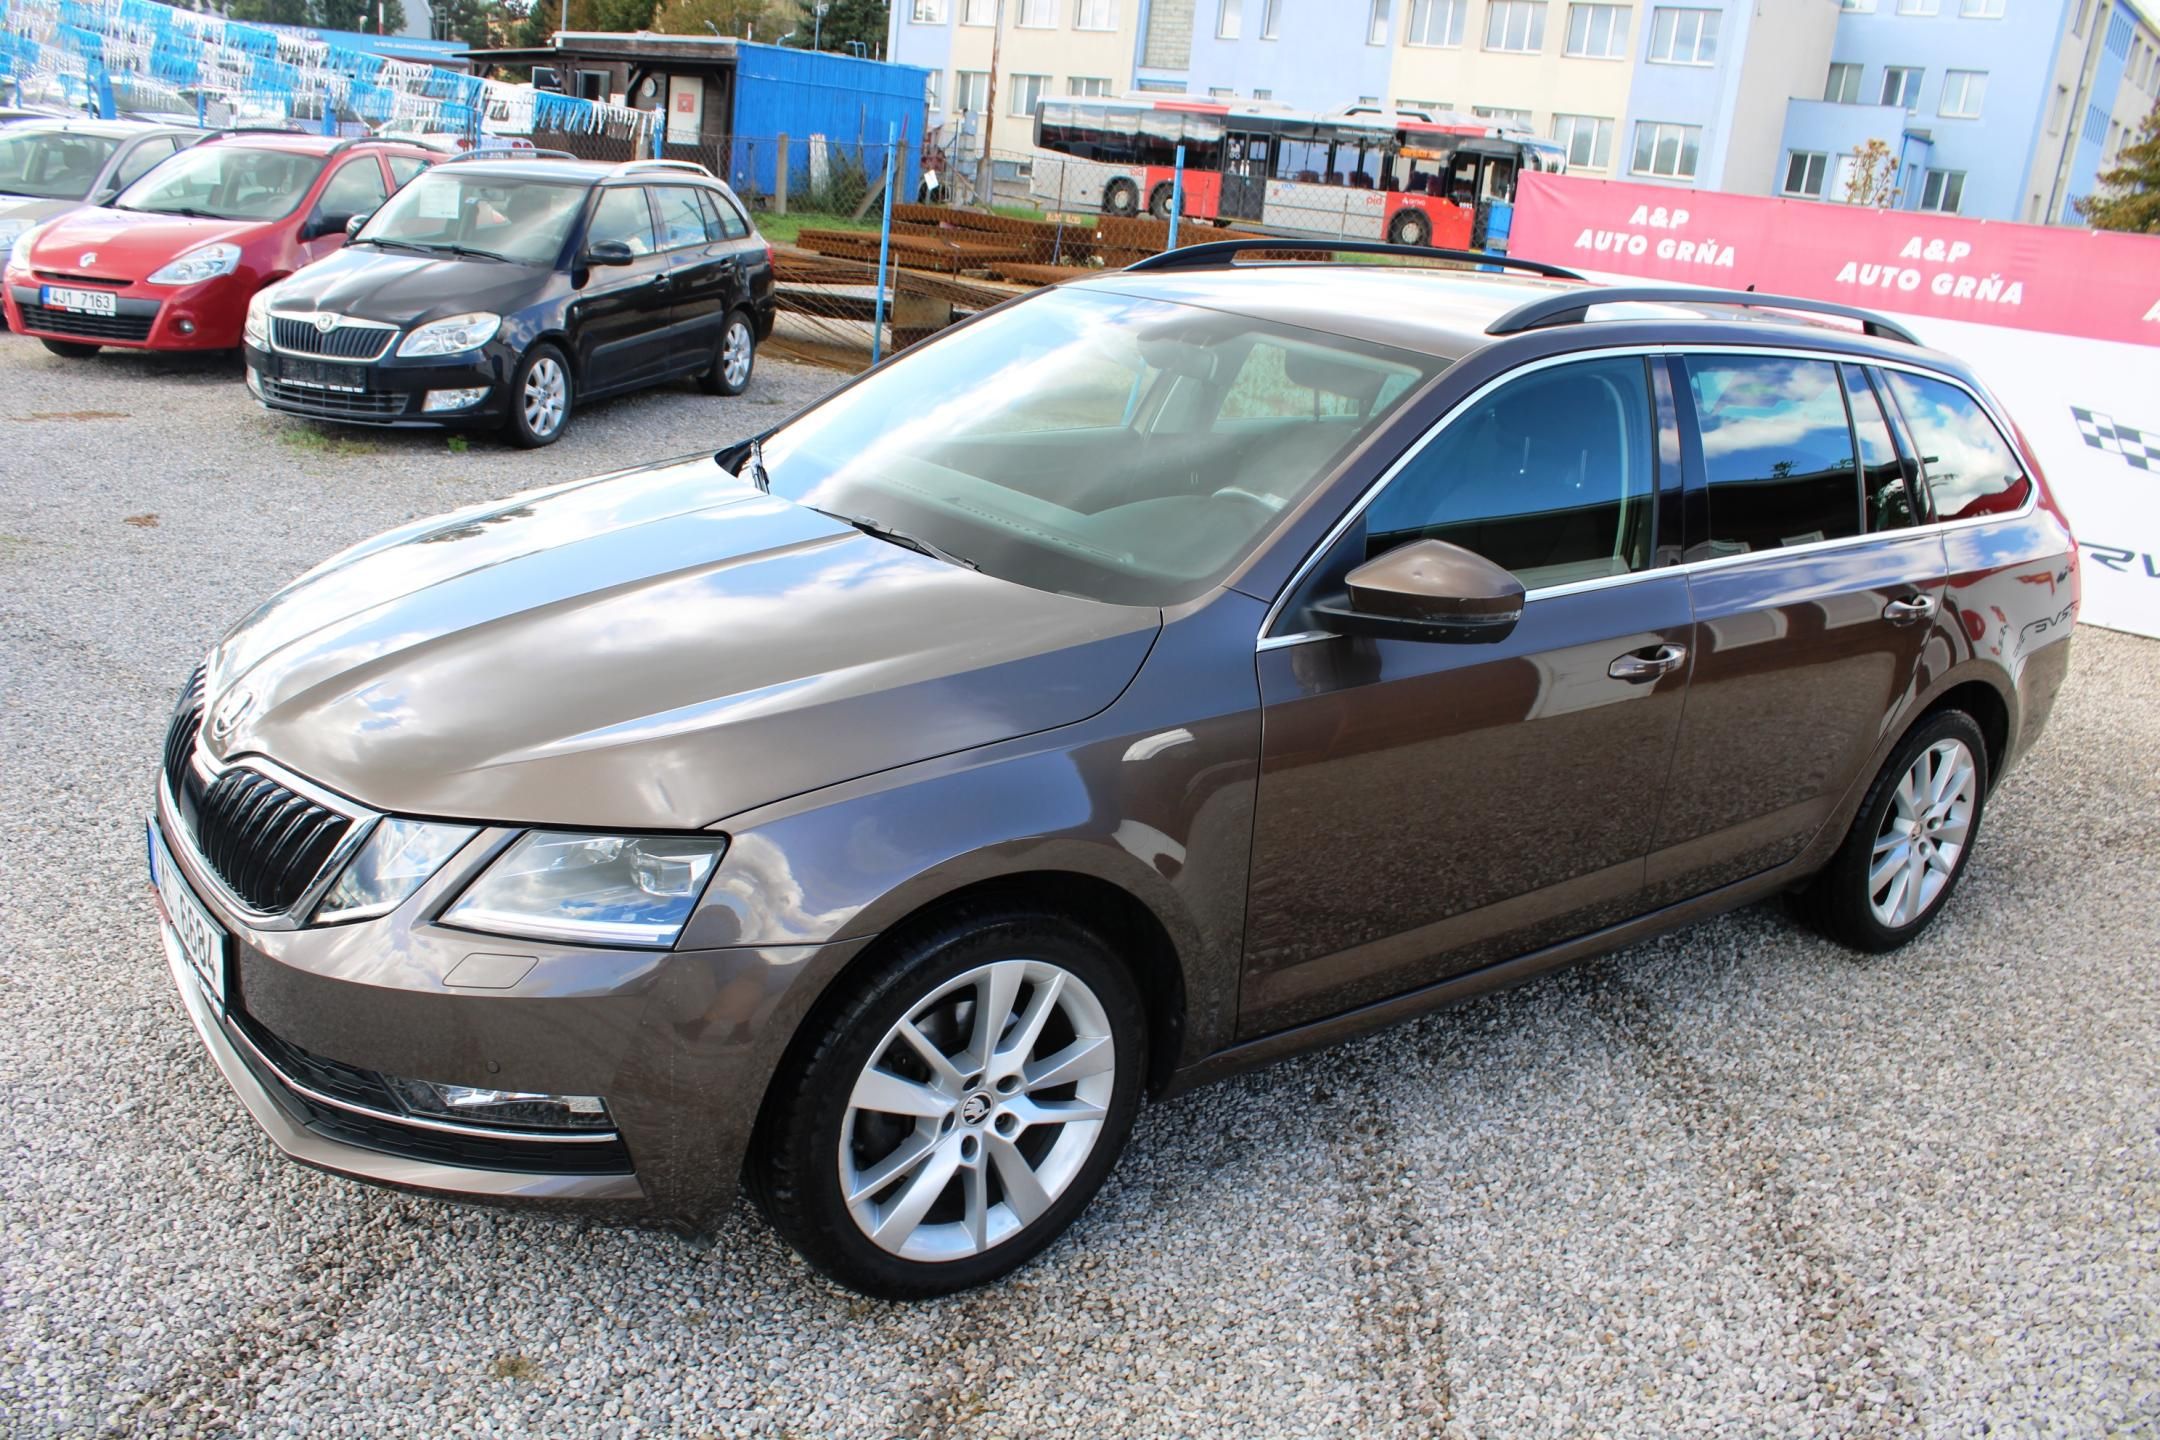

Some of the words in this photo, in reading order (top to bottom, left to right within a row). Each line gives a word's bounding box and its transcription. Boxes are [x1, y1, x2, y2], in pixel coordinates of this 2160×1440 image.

[1628, 204, 1690, 229] A&P
[1574, 228, 1648, 256] AUTO
[1656, 238, 1735, 268] GRŇA
[1899, 236, 1971, 263] A&P
[1835, 261, 1921, 291] AUTO
[1931, 272, 2024, 305] GRŇA
[52, 288, 72, 306] 4J1
[81, 292, 110, 309] 7163
